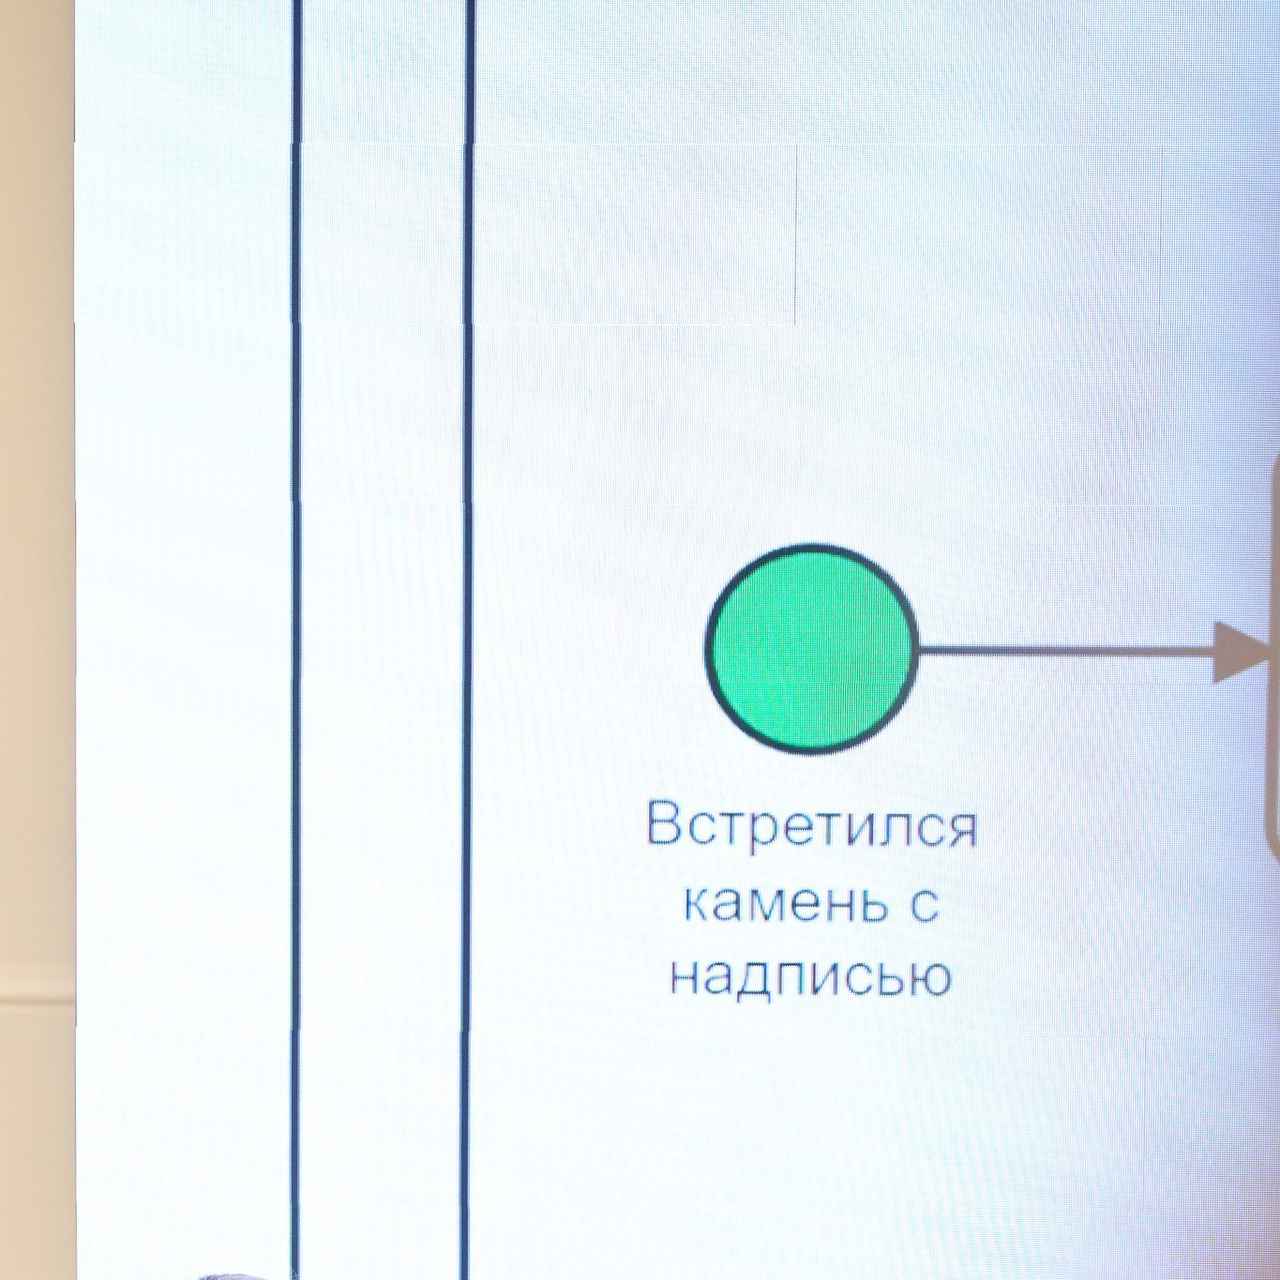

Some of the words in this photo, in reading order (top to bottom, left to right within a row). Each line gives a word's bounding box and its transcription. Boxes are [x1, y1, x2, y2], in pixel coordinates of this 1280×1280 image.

[648, 798, 978, 856] Встретился
[685, 888, 889, 922] камень
[911, 889, 940, 923] с
[671, 961, 952, 1004] надписью
